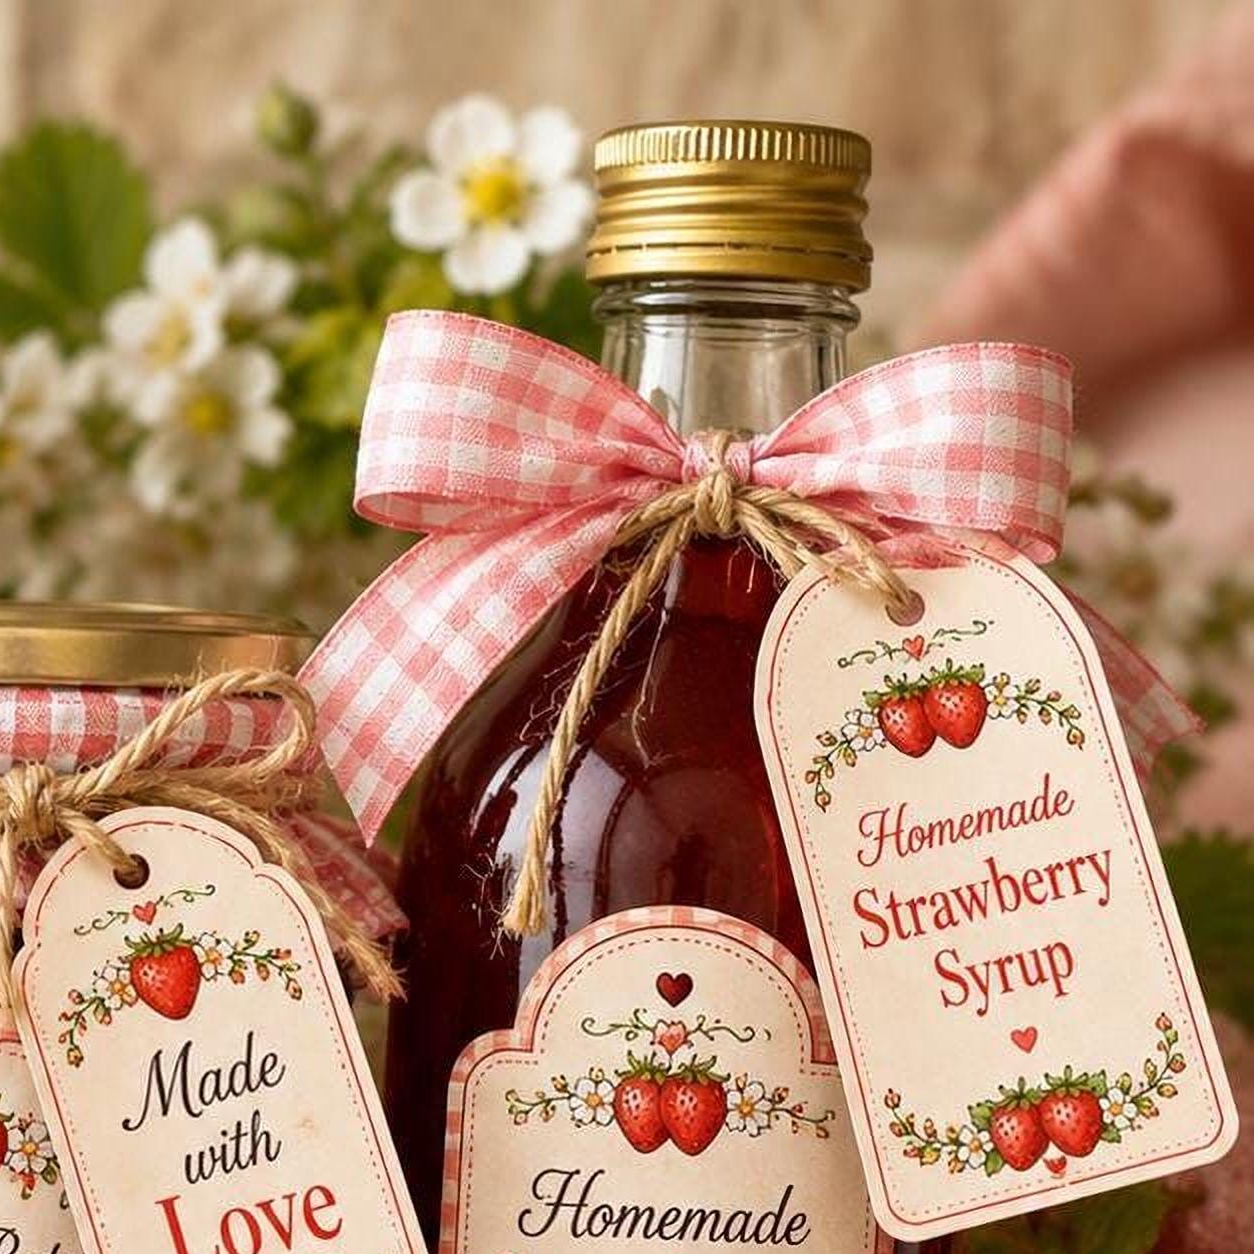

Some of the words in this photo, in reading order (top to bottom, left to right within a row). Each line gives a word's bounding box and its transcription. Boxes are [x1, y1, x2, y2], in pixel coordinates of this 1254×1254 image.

[856, 773, 1075, 867] Homemade
[852, 848, 1114, 950] Strawberry
[933, 938, 1075, 1017] Syrup
[122, 1031, 287, 1132] Made
[184, 1110, 282, 1185] with
[517, 1168, 811, 1246] Homemade
